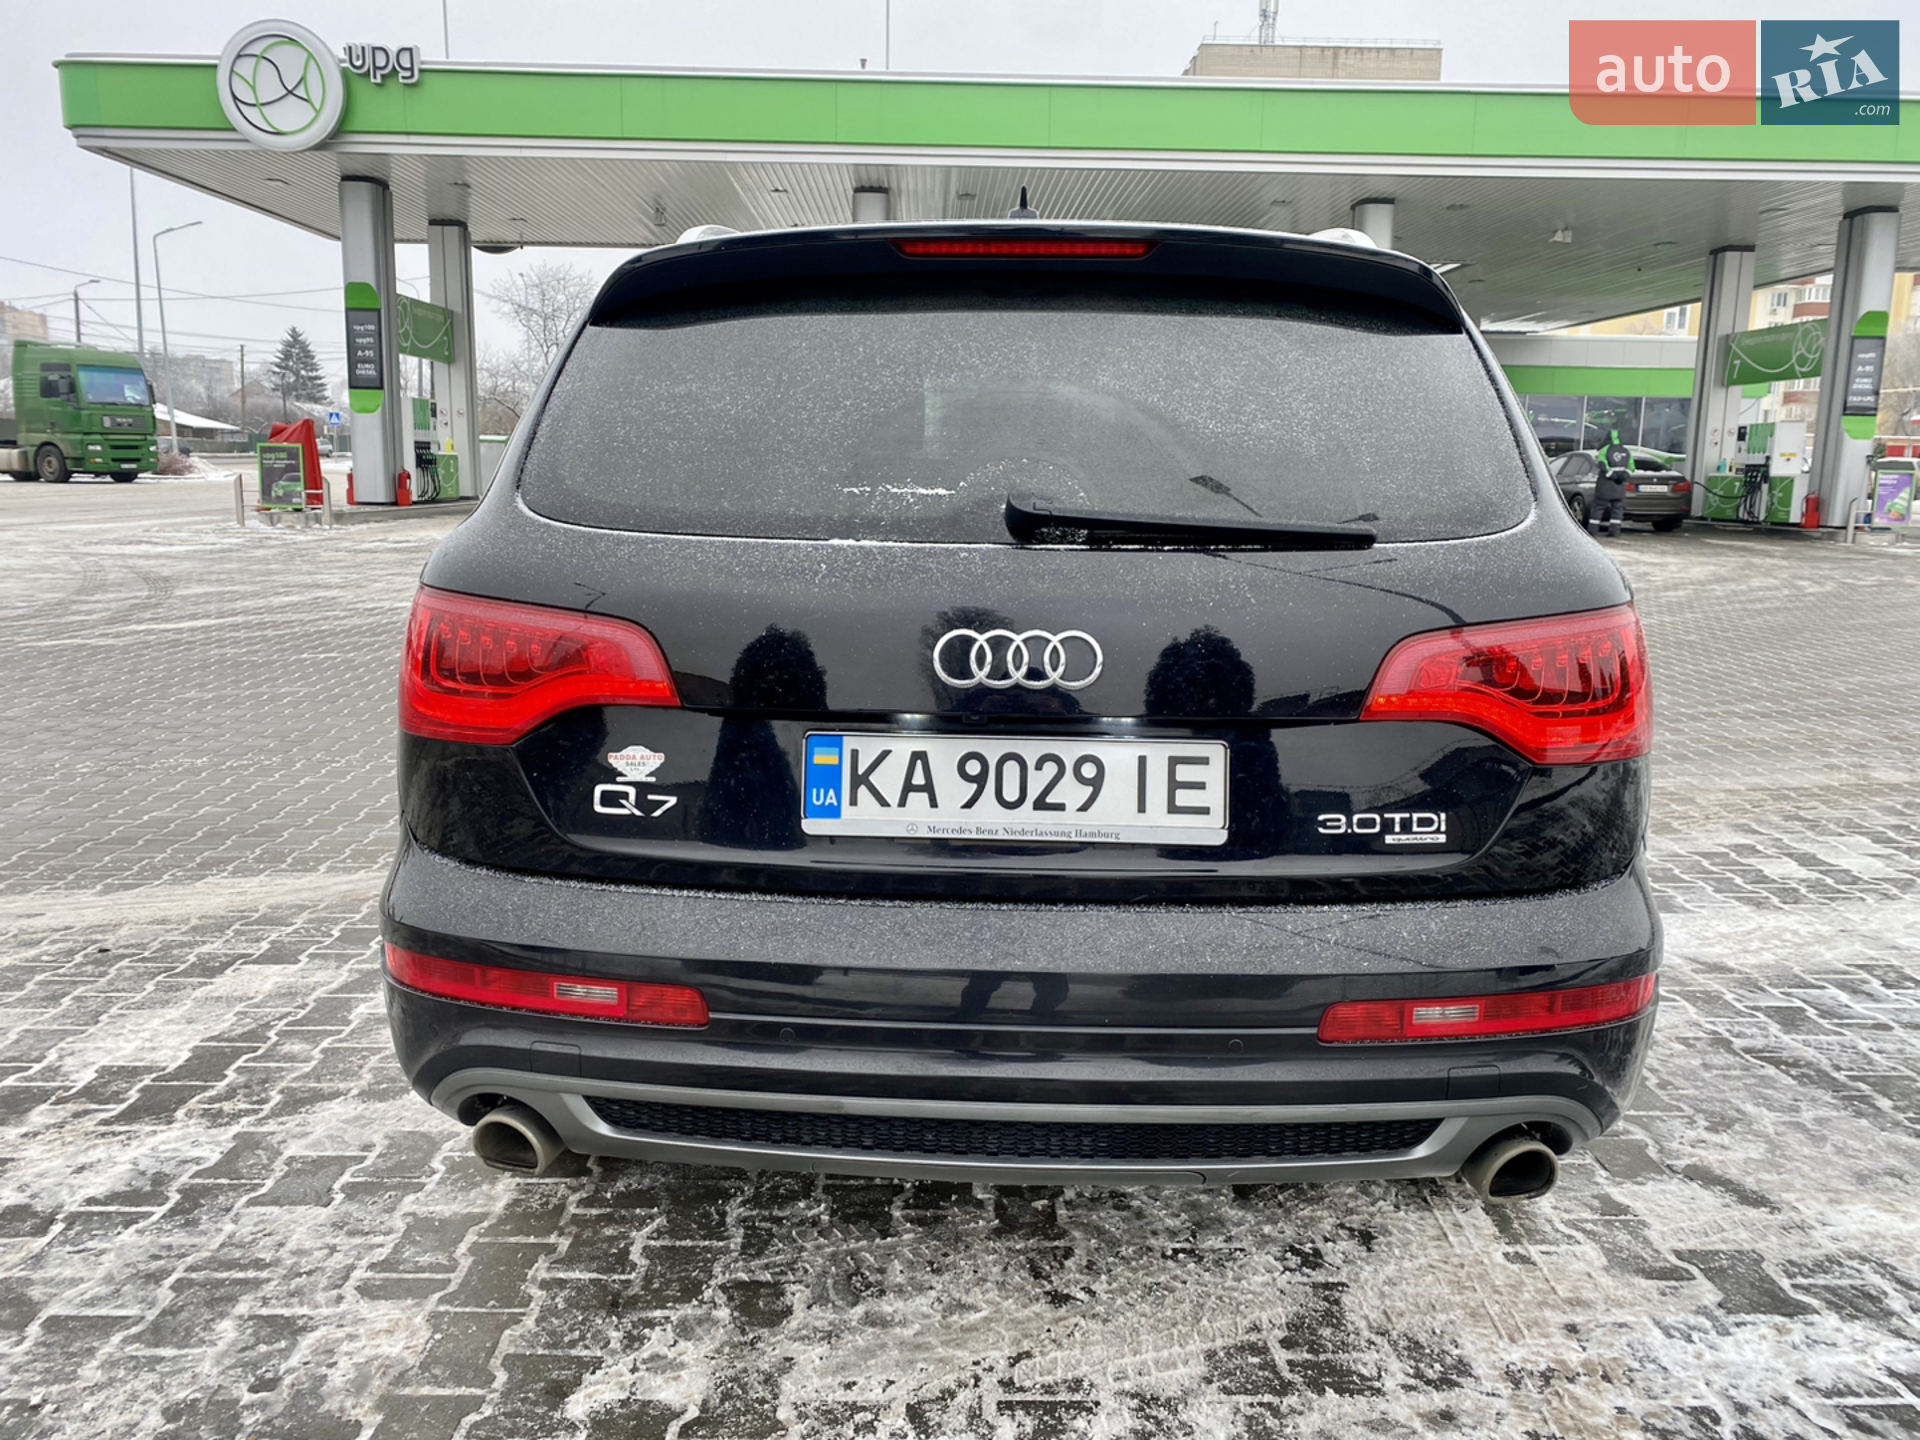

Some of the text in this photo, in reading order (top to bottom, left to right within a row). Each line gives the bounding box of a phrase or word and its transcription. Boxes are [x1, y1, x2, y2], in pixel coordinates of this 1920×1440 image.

[346, 44, 419, 83] upg
[443, 335, 449, 356] 2
[1732, 359, 1741, 379] 7
[1734, 481, 1741, 494] 7
[849, 748, 1211, 815] KA 9029 IE
[593, 784, 678, 817] Q7
[812, 788, 838, 806] UA
[927, 825, 1121, 841] Mercedes-Benz Niederlassung Hamburg
